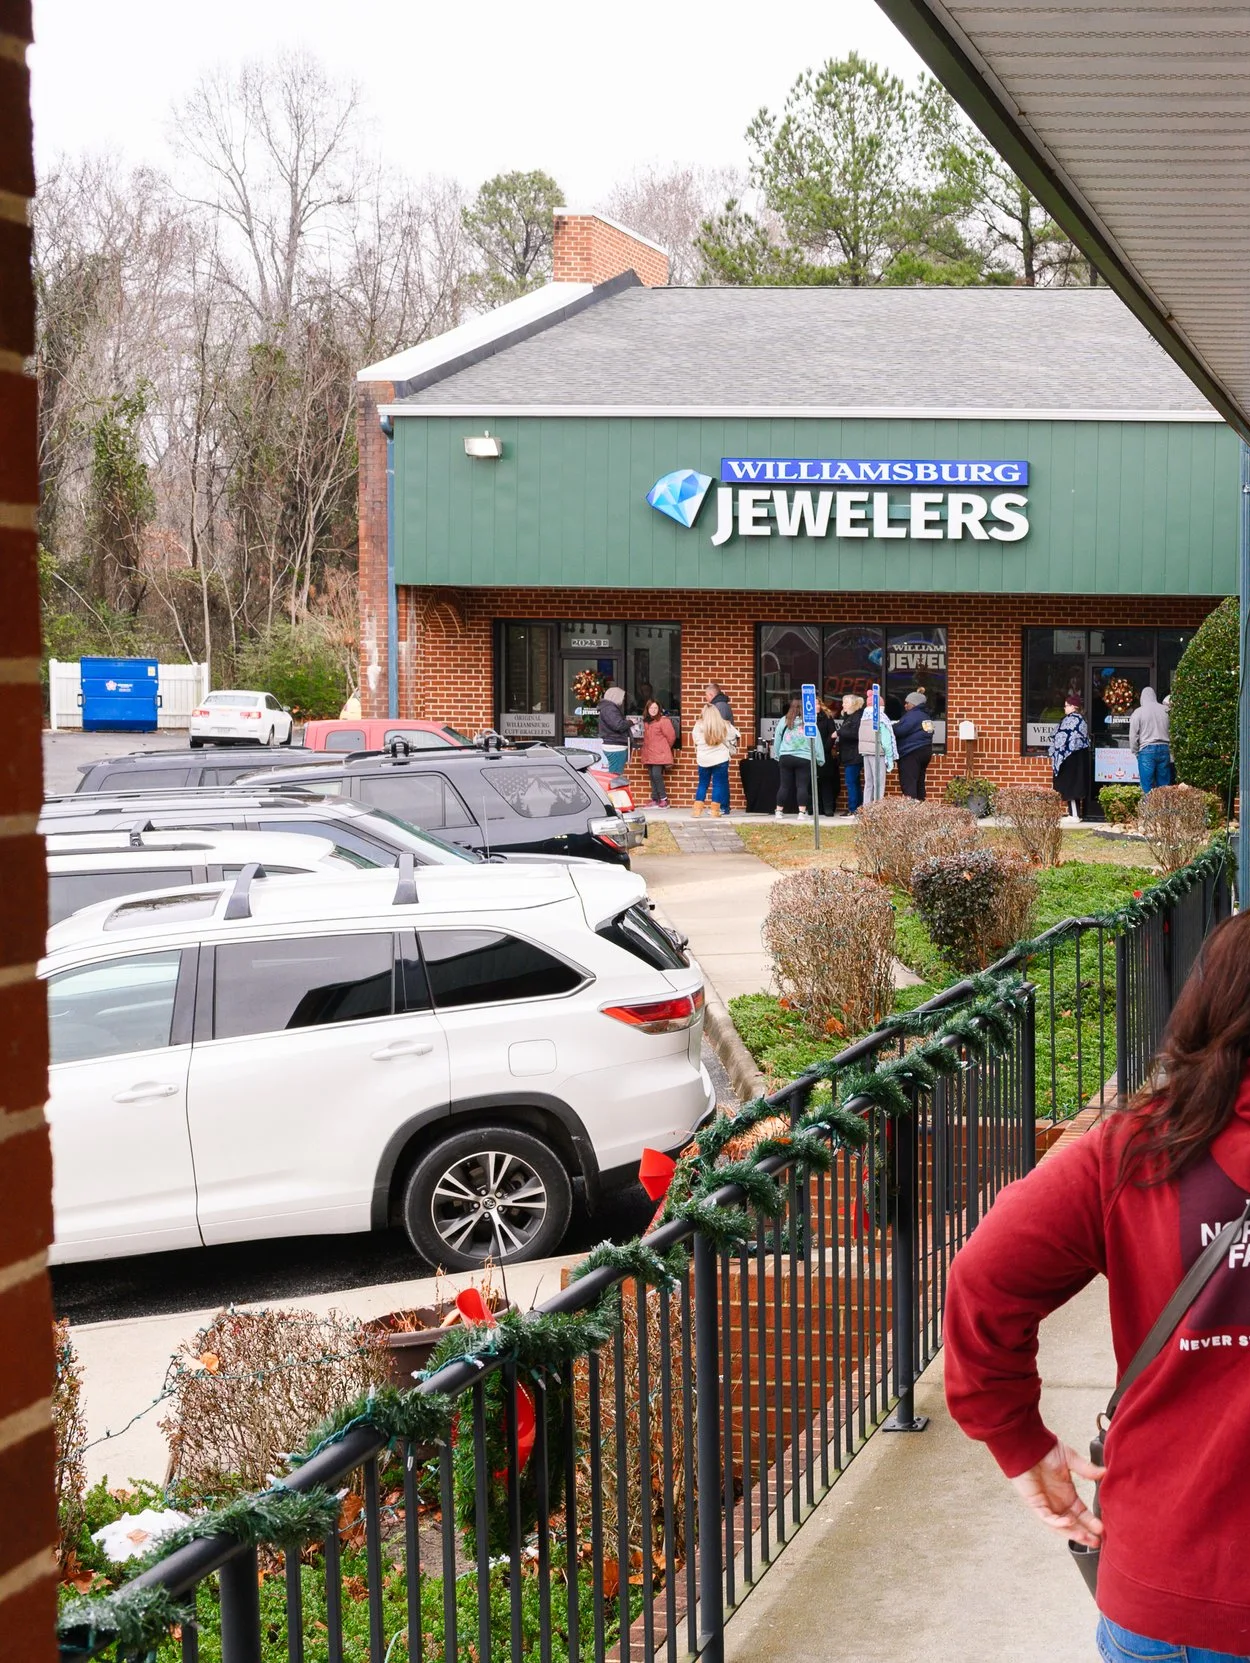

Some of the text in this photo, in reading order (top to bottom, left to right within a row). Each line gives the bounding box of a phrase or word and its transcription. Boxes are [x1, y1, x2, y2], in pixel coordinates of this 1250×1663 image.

[727, 461, 1021, 483] WILLIAMSBURG
[710, 487, 1029, 546] JEWELERS
[892, 644, 947, 652] WILLIAM
[1180, 1335, 1232, 1351] NEVER
